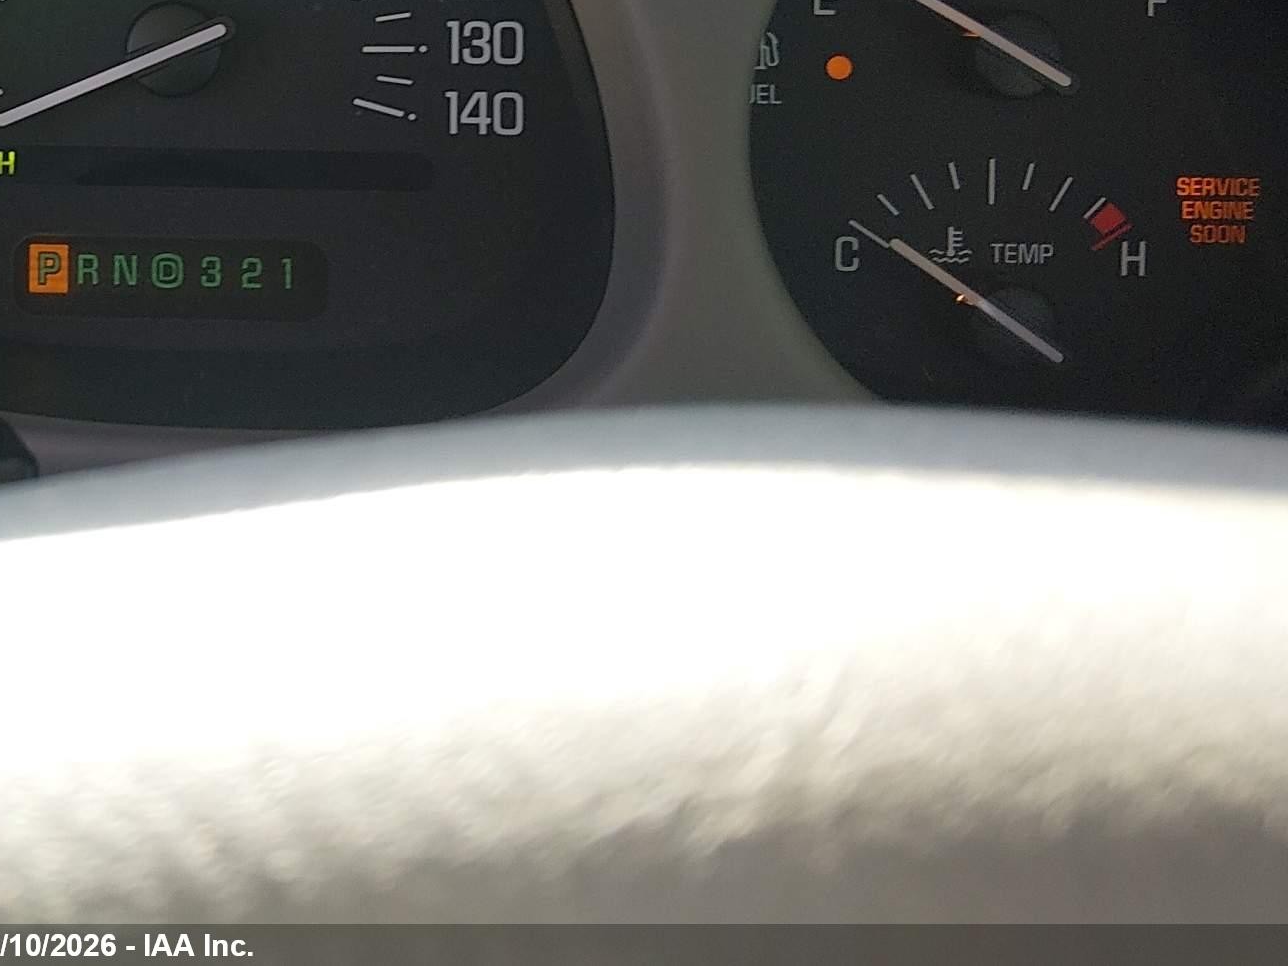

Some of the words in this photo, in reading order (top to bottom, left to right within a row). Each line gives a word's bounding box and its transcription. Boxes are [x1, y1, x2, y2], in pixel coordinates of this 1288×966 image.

[447, 21, 523, 64] 130
[445, 92, 523, 135] 140
[1177, 177, 1258, 195] SERVICE
[1182, 201, 1252, 219] ENGINE
[1190, 224, 1245, 243] SOON
[836, 237, 859, 271] C
[991, 244, 1053, 263] TEMP
[1121, 241, 1145, 276] H
[37, 253, 61, 285] P
[78, 255, 98, 284] R
[114, 255, 137, 285] N
[152, 254, 183, 288] D
[201, 257, 221, 286] 3
[242, 258, 262, 288] 2
[282, 259, 291, 289] 1
